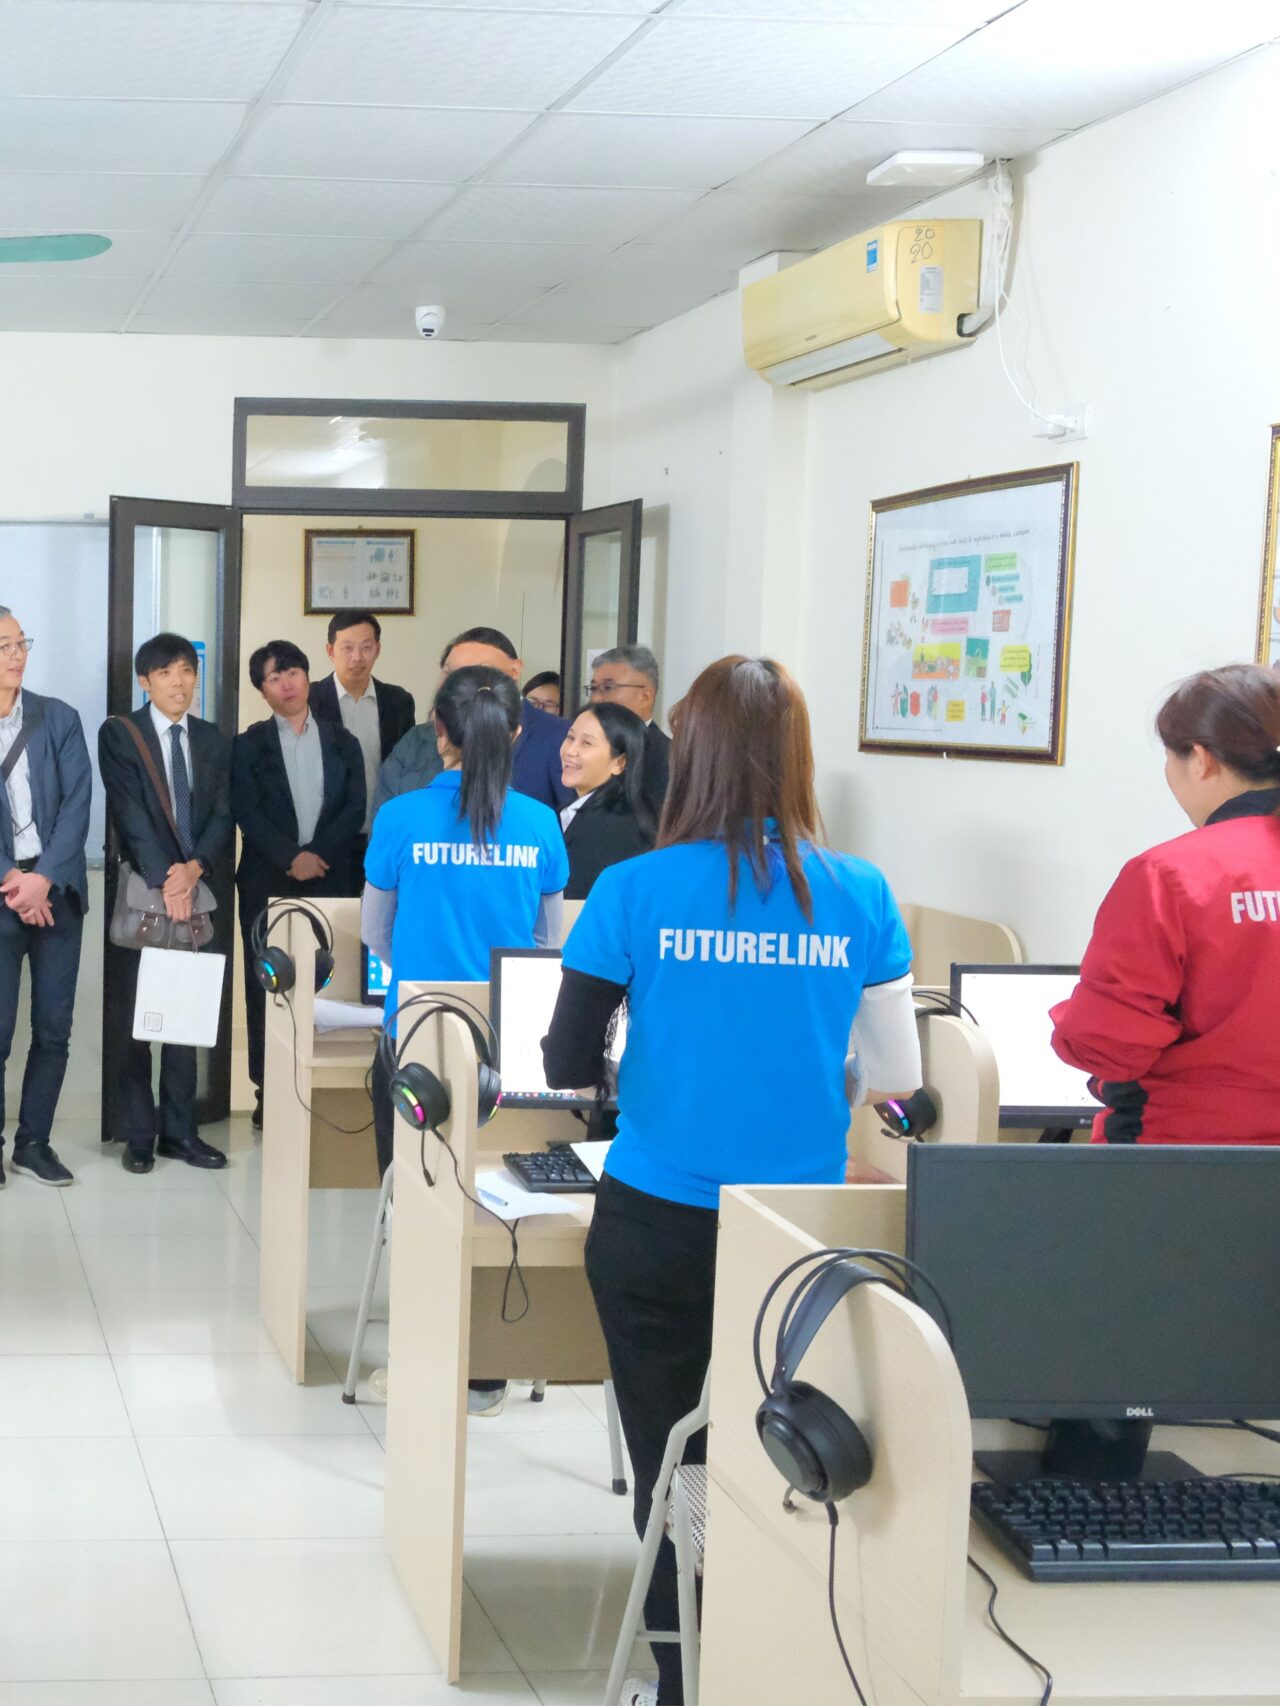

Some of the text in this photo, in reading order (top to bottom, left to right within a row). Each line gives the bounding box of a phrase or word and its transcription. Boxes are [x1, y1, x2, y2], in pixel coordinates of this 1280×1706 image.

[412, 842, 539, 868] FUTURELINK
[1231, 890, 1280, 924] FUT
[659, 928, 851, 968] FUTURELINK
[1126, 1407, 1154, 1417] DELL
